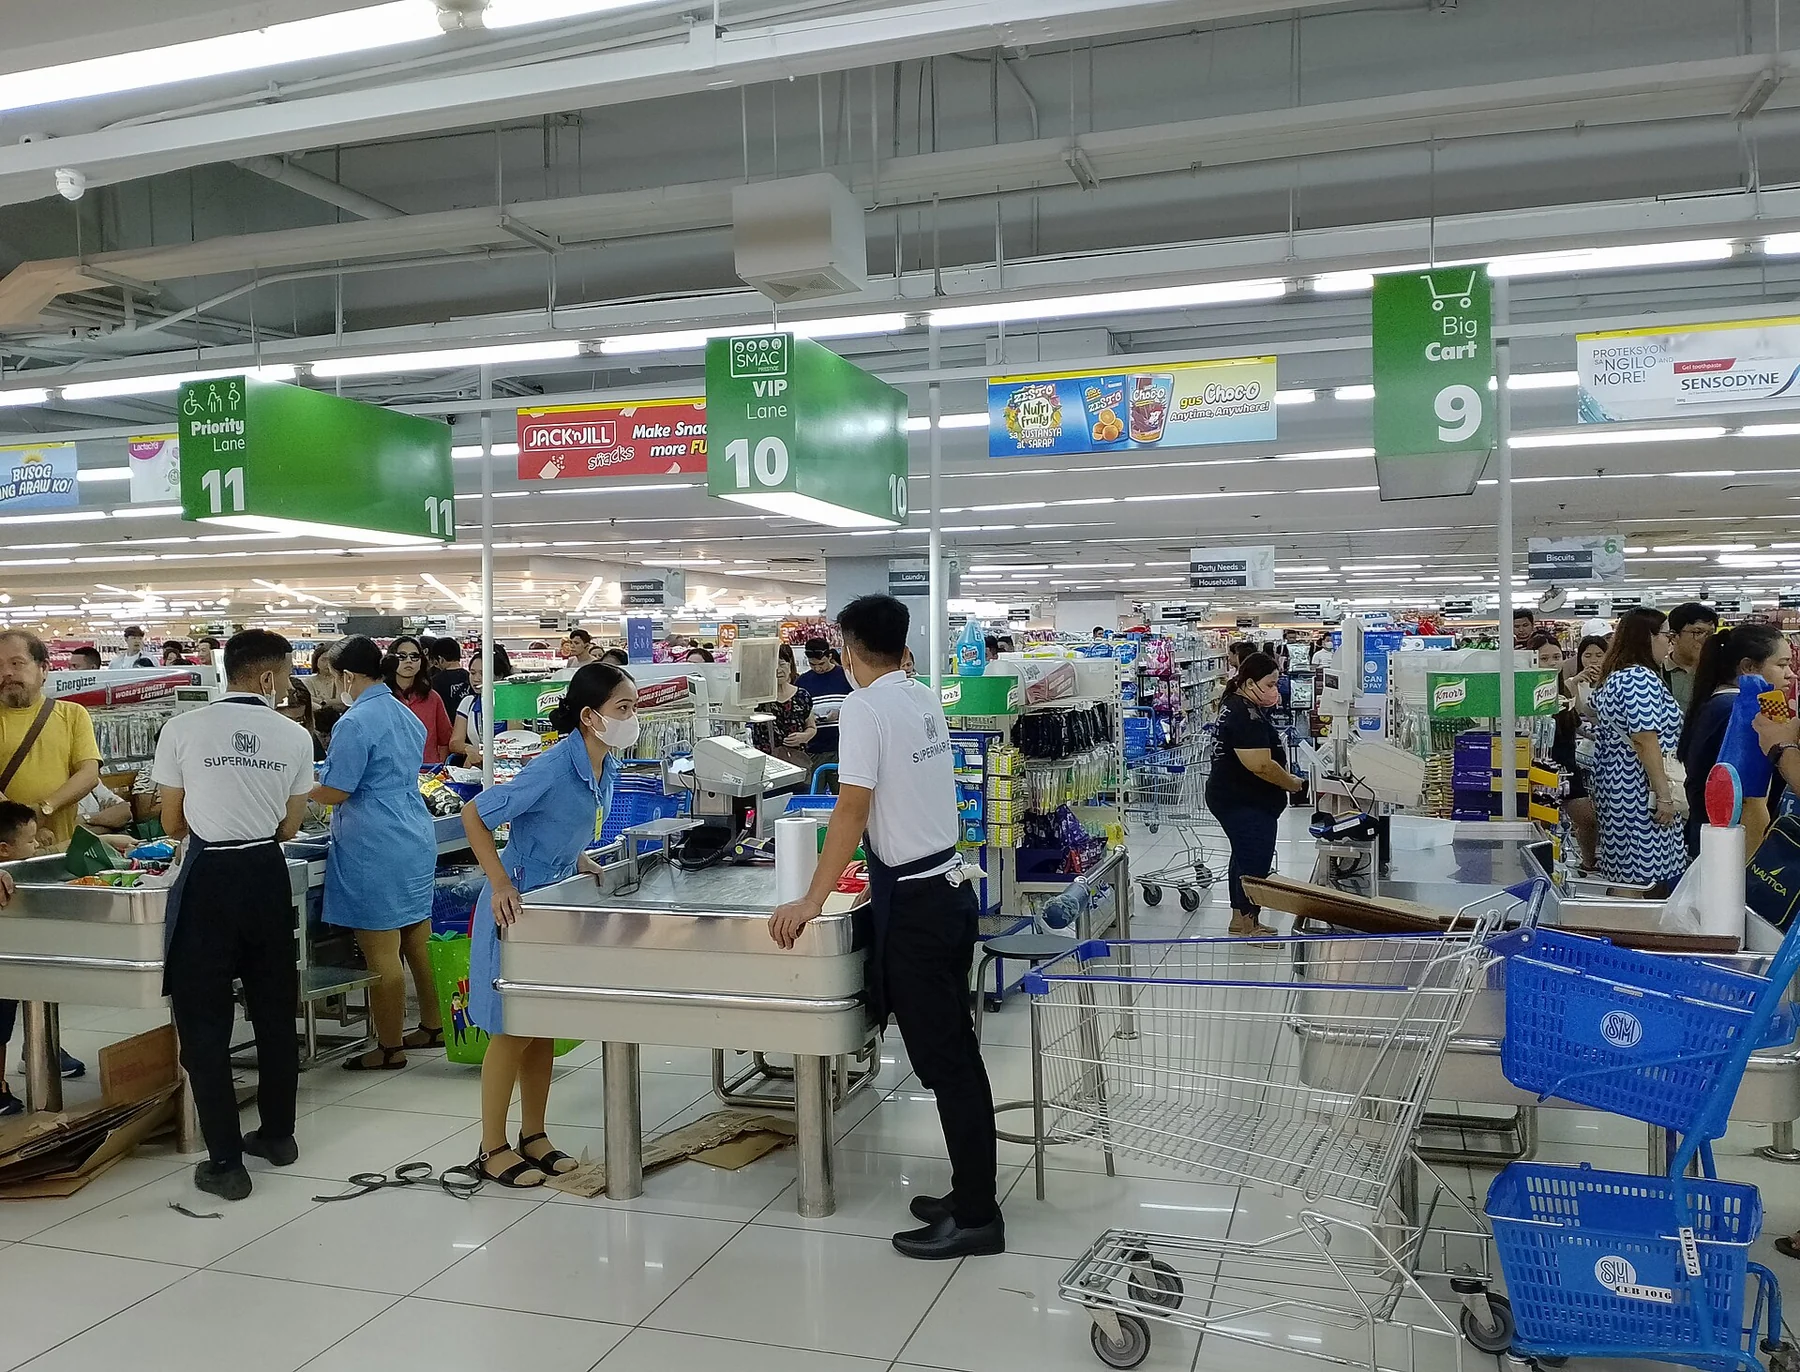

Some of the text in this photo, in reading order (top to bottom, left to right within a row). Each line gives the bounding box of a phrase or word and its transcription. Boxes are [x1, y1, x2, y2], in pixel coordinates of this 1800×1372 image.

[1443, 316, 1477, 338] Big
[736, 351, 780, 368] SMAC
[1425, 341, 1477, 361] Cart
[1593, 344, 1667, 359] PROTEKSYON
[1604, 356, 1656, 371] NGILO
[1593, 371, 1646, 386] MORE!
[1681, 372, 1780, 391] SENSODYNE
[752, 379, 788, 398] VIP
[746, 402, 788, 420] Lane
[1023, 401, 1049, 416] Nutri
[1170, 401, 1270, 422] Anytime, Anywhere!
[1180, 396, 1202, 410] gus
[1434, 384, 1482, 442] 9
[191, 417, 245, 436] Priority
[632, 423, 671, 440] Make
[213, 437, 245, 452] Lane
[650, 444, 686, 457] more
[587, 445, 635, 471] snacks
[725, 436, 789, 489] 10
[12, 464, 52, 482] BUSOG
[19, 479, 51, 495] ARAW
[51, 478, 73, 494] KO!
[201, 466, 245, 513] 11
[888, 473, 907, 518] 10
[425, 496, 453, 536] 11
[1604, 538, 1617, 554] 6
[1258, 551, 1270, 570] 7
[1546, 554, 1575, 562] Biscuits
[1197, 563, 1239, 573] Party Needs
[901, 572, 926, 582] Laundry
[1198, 578, 1238, 586] Households
[630, 583, 654, 591] Imported
[630, 596, 655, 604] Shampoo
[721, 628, 735, 639] 45
[55, 675, 97, 693] Energizer
[1434, 687, 1464, 703] Knorr
[234, 732, 256, 754] SM
[204, 756, 288, 773] SUPERMARKET
[1751, 863, 1787, 897] NAUTICA
[1605, 1014, 1636, 1043] SM
[1600, 1260, 1629, 1285] SM
[1615, 1285, 1672, 1300] CEB 1016
